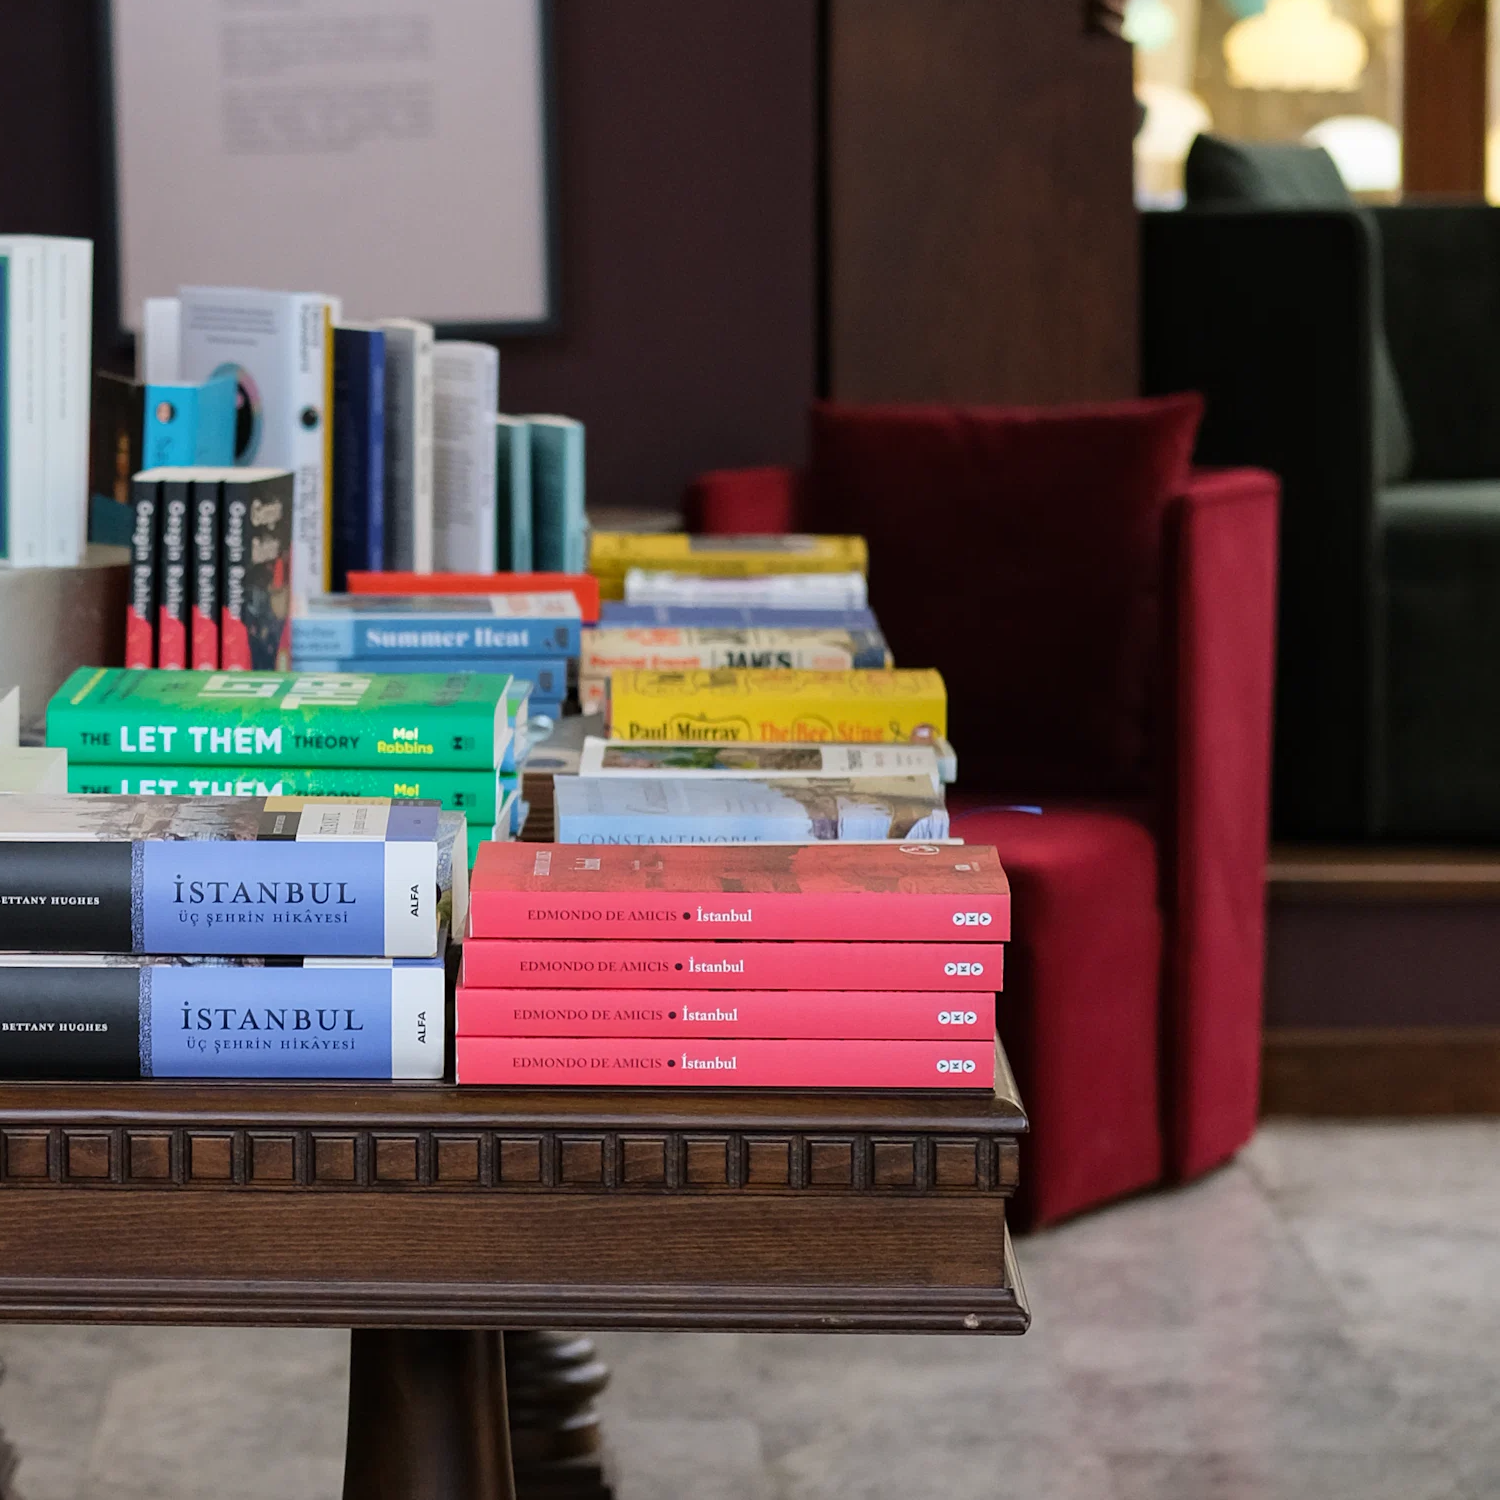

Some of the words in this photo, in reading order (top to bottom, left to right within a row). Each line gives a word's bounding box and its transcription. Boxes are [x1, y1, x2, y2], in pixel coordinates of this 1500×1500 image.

[366, 629, 470, 648] Summer
[474, 627, 530, 648] Heat
[725, 651, 792, 670] JAMES
[392, 727, 419, 741] Mel
[629, 720, 668, 741] Paul
[676, 721, 741, 742] Murray
[759, 721, 790, 742] The
[796, 721, 826, 742] Bee
[836, 721, 885, 742] Sting
[80, 732, 112, 746] THE
[120, 726, 178, 753] LET
[188, 726, 283, 754] THEM
[293, 735, 360, 750] THEORY
[377, 741, 434, 754] Robbins
[393, 783, 420, 797] Mel
[173, 874, 357, 904] İSTANBUL
[50, 895, 100, 905] HUGHES
[410, 884, 419, 917] ALFA
[179, 910, 199, 927] ÜÇ
[206, 910, 264, 927] ŞEHRİN
[273, 909, 348, 924] HİKÂYESİ
[528, 909, 602, 922] EDMONDO
[606, 909, 627, 922] DE
[628, 909, 677, 922] AMICIS
[696, 905, 753, 922] İstanbul
[953, 912, 992, 926] YKY
[520, 960, 595, 973] EDMONDO
[598, 960, 618, 973] DE
[620, 960, 669, 973] AMICIS
[688, 956, 745, 973] İstanbul
[944, 962, 984, 976] YKY
[180, 1001, 364, 1031] İSTANBUL
[513, 1009, 588, 1021] EDMONDO
[591, 1009, 611, 1021] DE
[613, 1009, 663, 1021] AMICIS
[682, 1005, 739, 1022] İstanbul
[937, 1011, 977, 1025] YKY
[1, 1022, 55, 1032] BETTANY
[58, 1022, 108, 1032] HUGHES
[417, 1011, 426, 1044] ALFA
[186, 1036, 207, 1053] ÜÇ
[214, 1037, 272, 1054] ŞEHRİN
[280, 1036, 356, 1050] HİKÂYESİ
[512, 1057, 587, 1069] EDMONDO
[590, 1057, 611, 1069] DE
[612, 1057, 662, 1069] AMICIS
[681, 1053, 737, 1070] İstanbul
[936, 1059, 976, 1074] YKY
